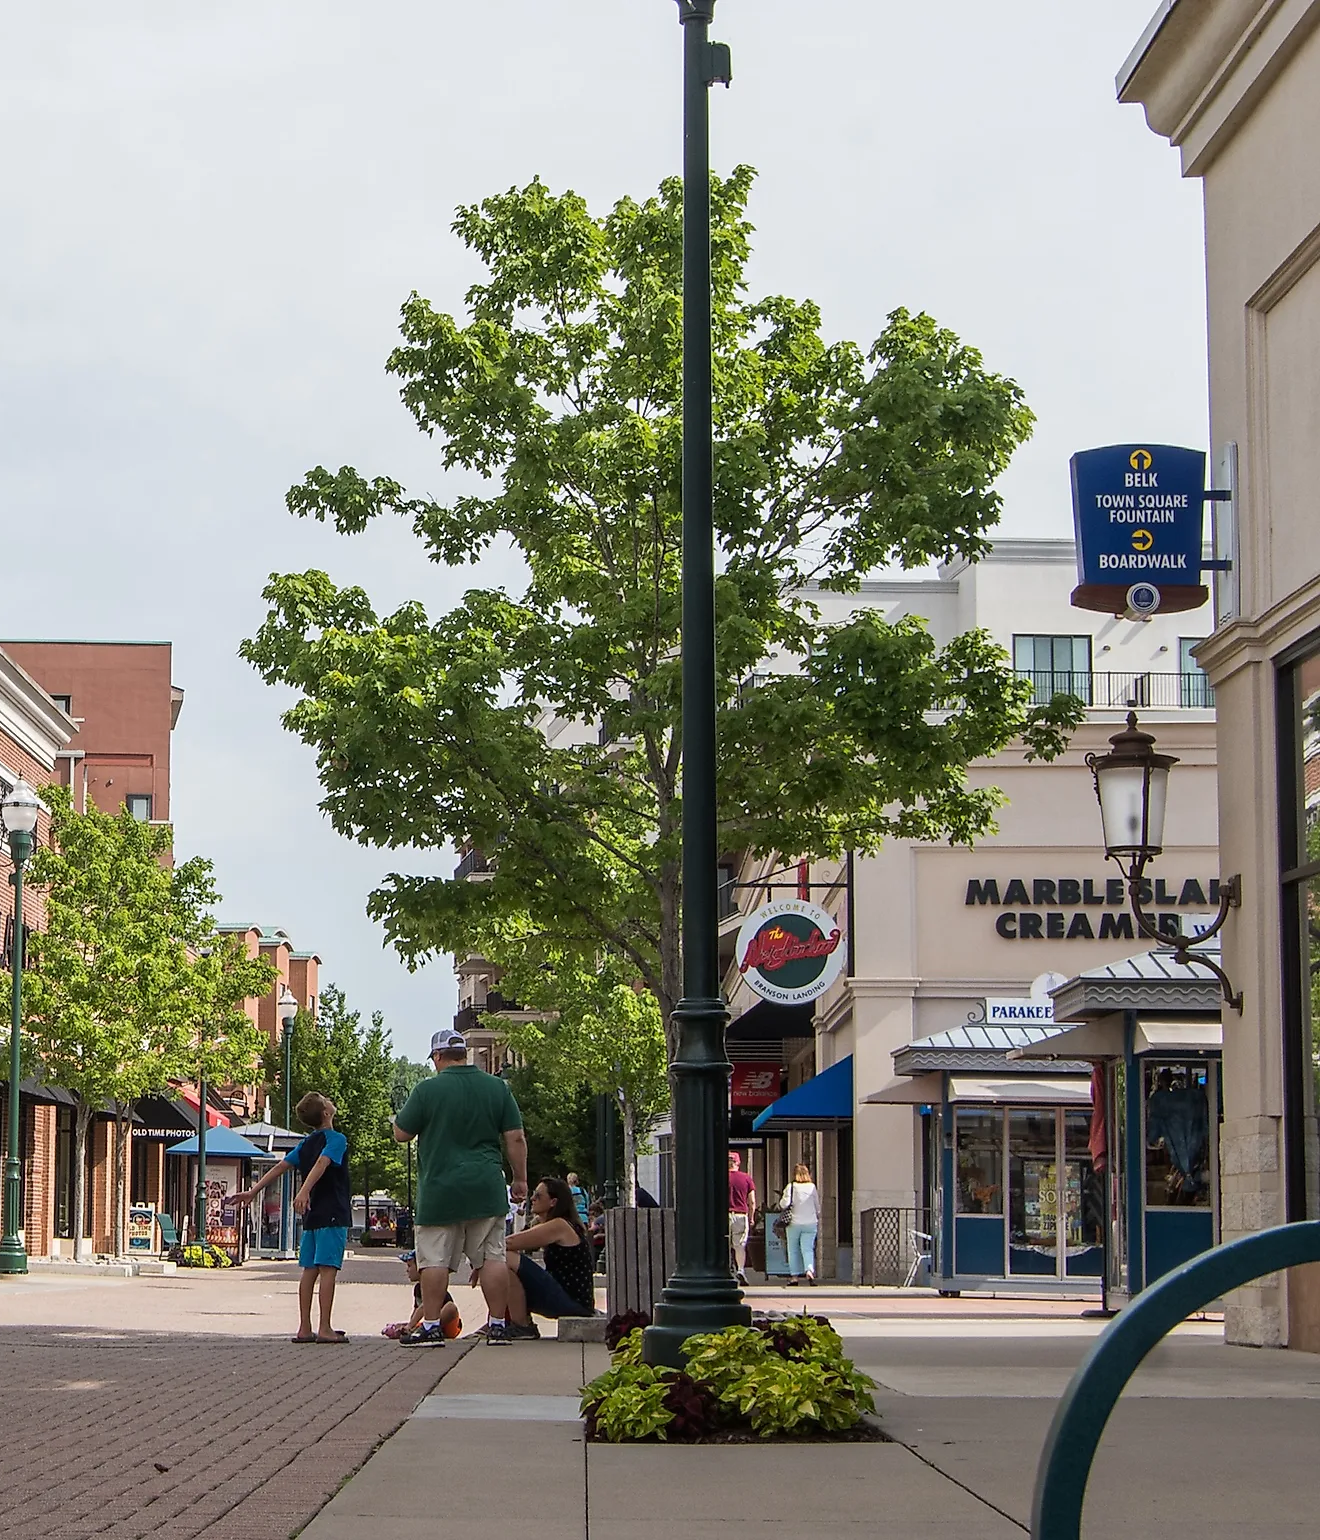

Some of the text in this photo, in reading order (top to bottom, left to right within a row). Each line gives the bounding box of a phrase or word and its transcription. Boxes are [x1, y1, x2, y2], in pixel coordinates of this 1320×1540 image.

[1125, 473, 1158, 487] BELK
[1096, 495, 1188, 508] TOWN SQUARE
[1110, 510, 1175, 523] FOUNTAIN
[1099, 554, 1187, 569] BOARDWALK
[965, 878, 1125, 905] MARBLE
[760, 903, 821, 920] WELCOME TO
[995, 912, 1181, 939] CREAMER
[769, 928, 784, 940] The
[739, 929, 840, 973] Neighborhood
[754, 980, 826, 1000] BRANSON LANDING
[991, 1006, 1054, 1019] PARAKEE
[132, 1128, 196, 1138] OLD TIME PHOTOS
